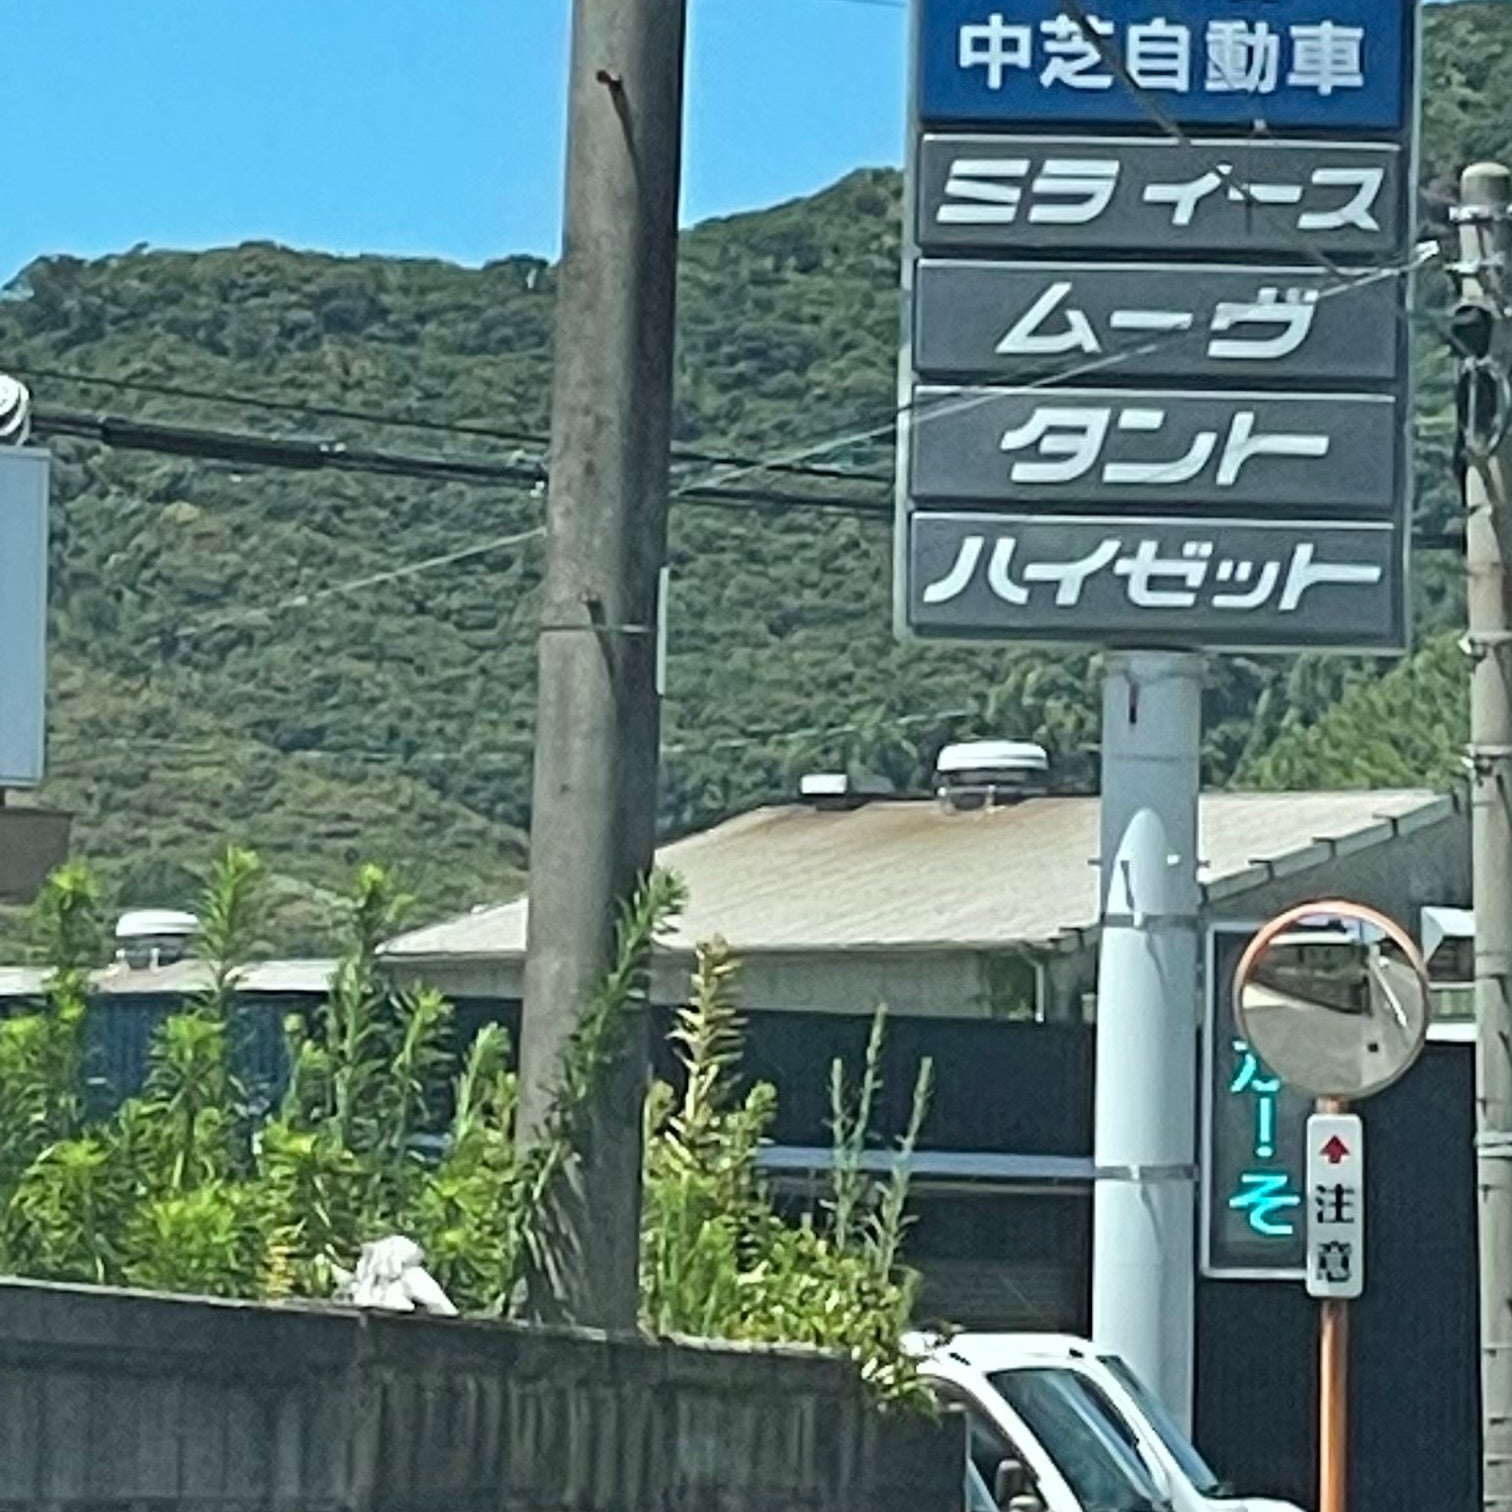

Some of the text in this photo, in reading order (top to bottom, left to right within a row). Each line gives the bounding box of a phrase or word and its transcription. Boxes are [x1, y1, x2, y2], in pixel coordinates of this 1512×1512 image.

[959, 13, 1364, 95] 中芝自動車
[995, 282, 1319, 359] ムーヴ
[1001, 407, 1329, 485] タント
[922, 535, 1381, 610] ハイゼット
